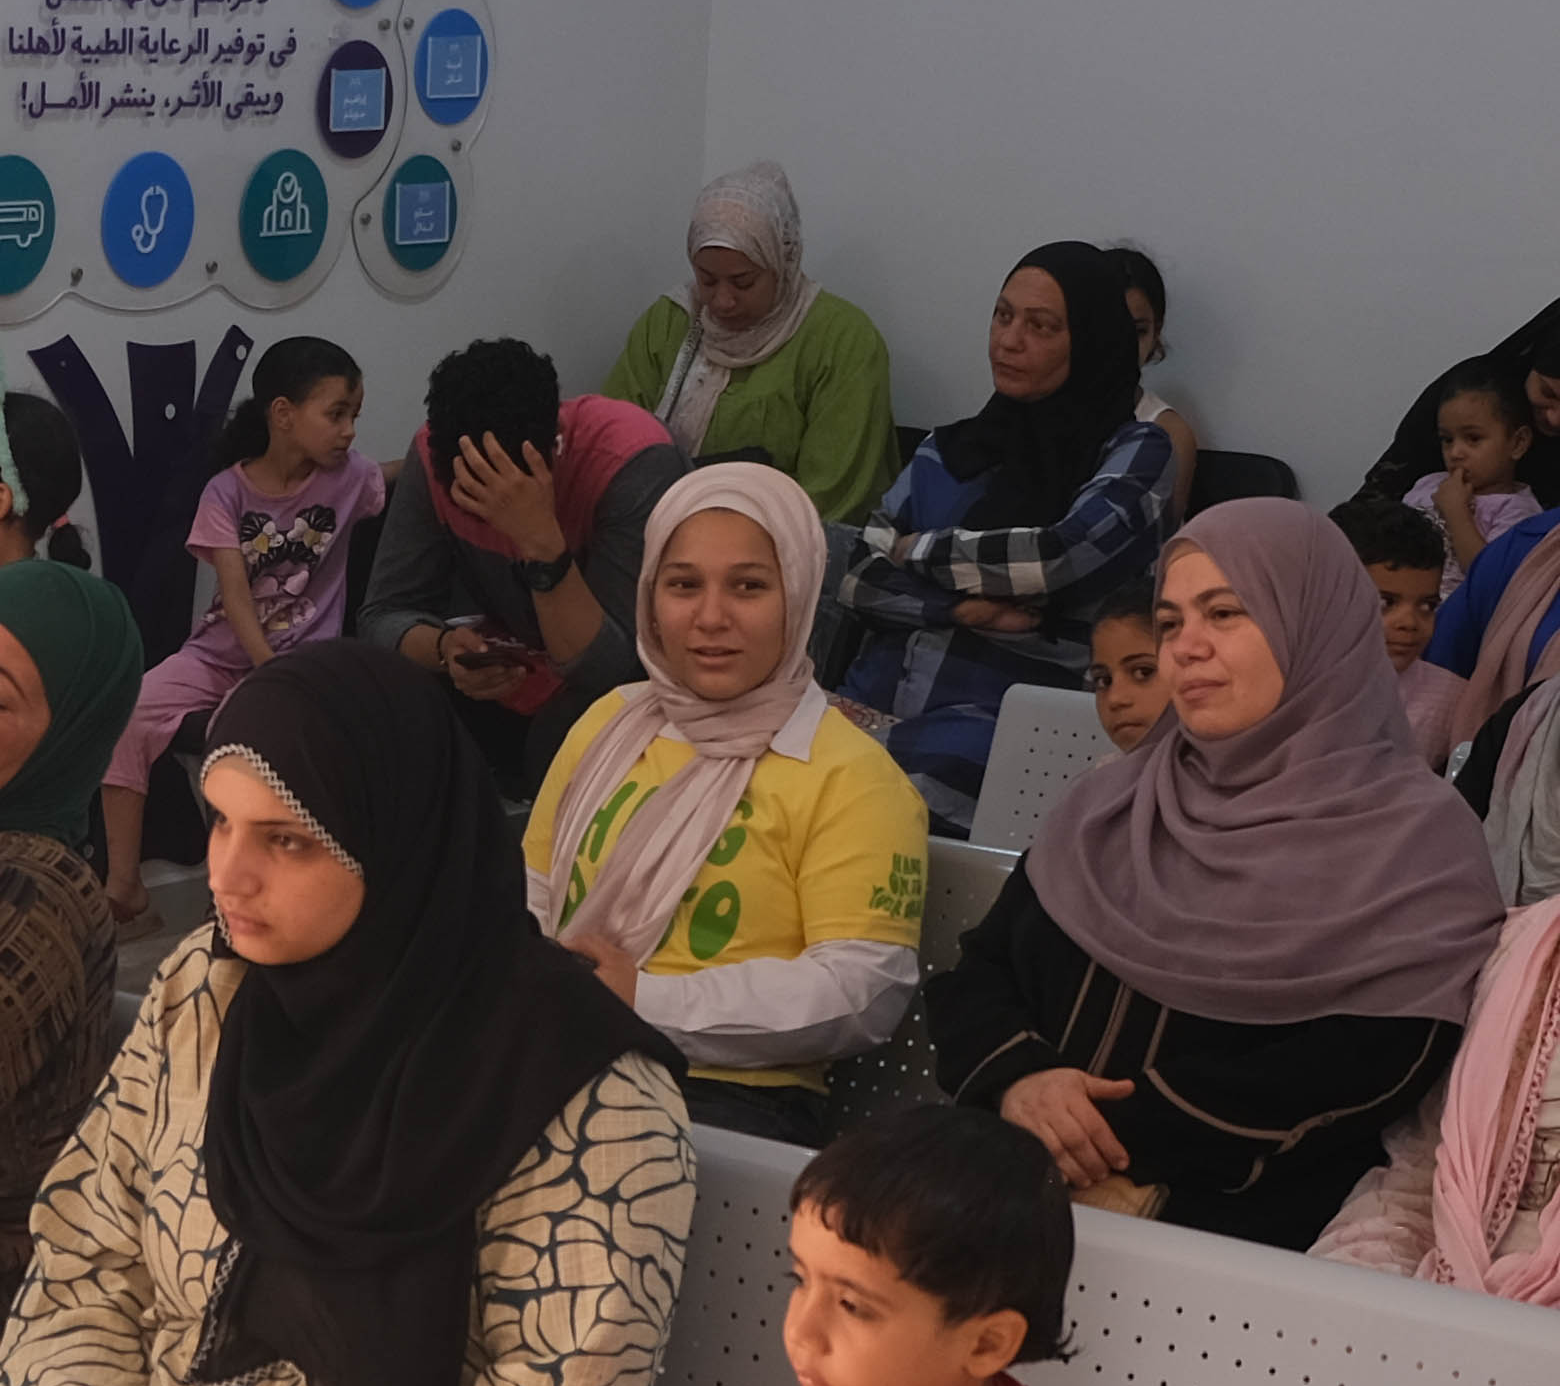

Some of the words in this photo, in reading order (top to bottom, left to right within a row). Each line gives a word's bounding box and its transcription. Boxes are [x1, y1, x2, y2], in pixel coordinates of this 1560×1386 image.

[8, 16, 67, 56] لأهلنا
[71, 26, 134, 64] الطبية
[138, 26, 210, 65] الرعاية
[211, 27, 266, 66] توفير
[102, 82, 156, 118] ينشر
